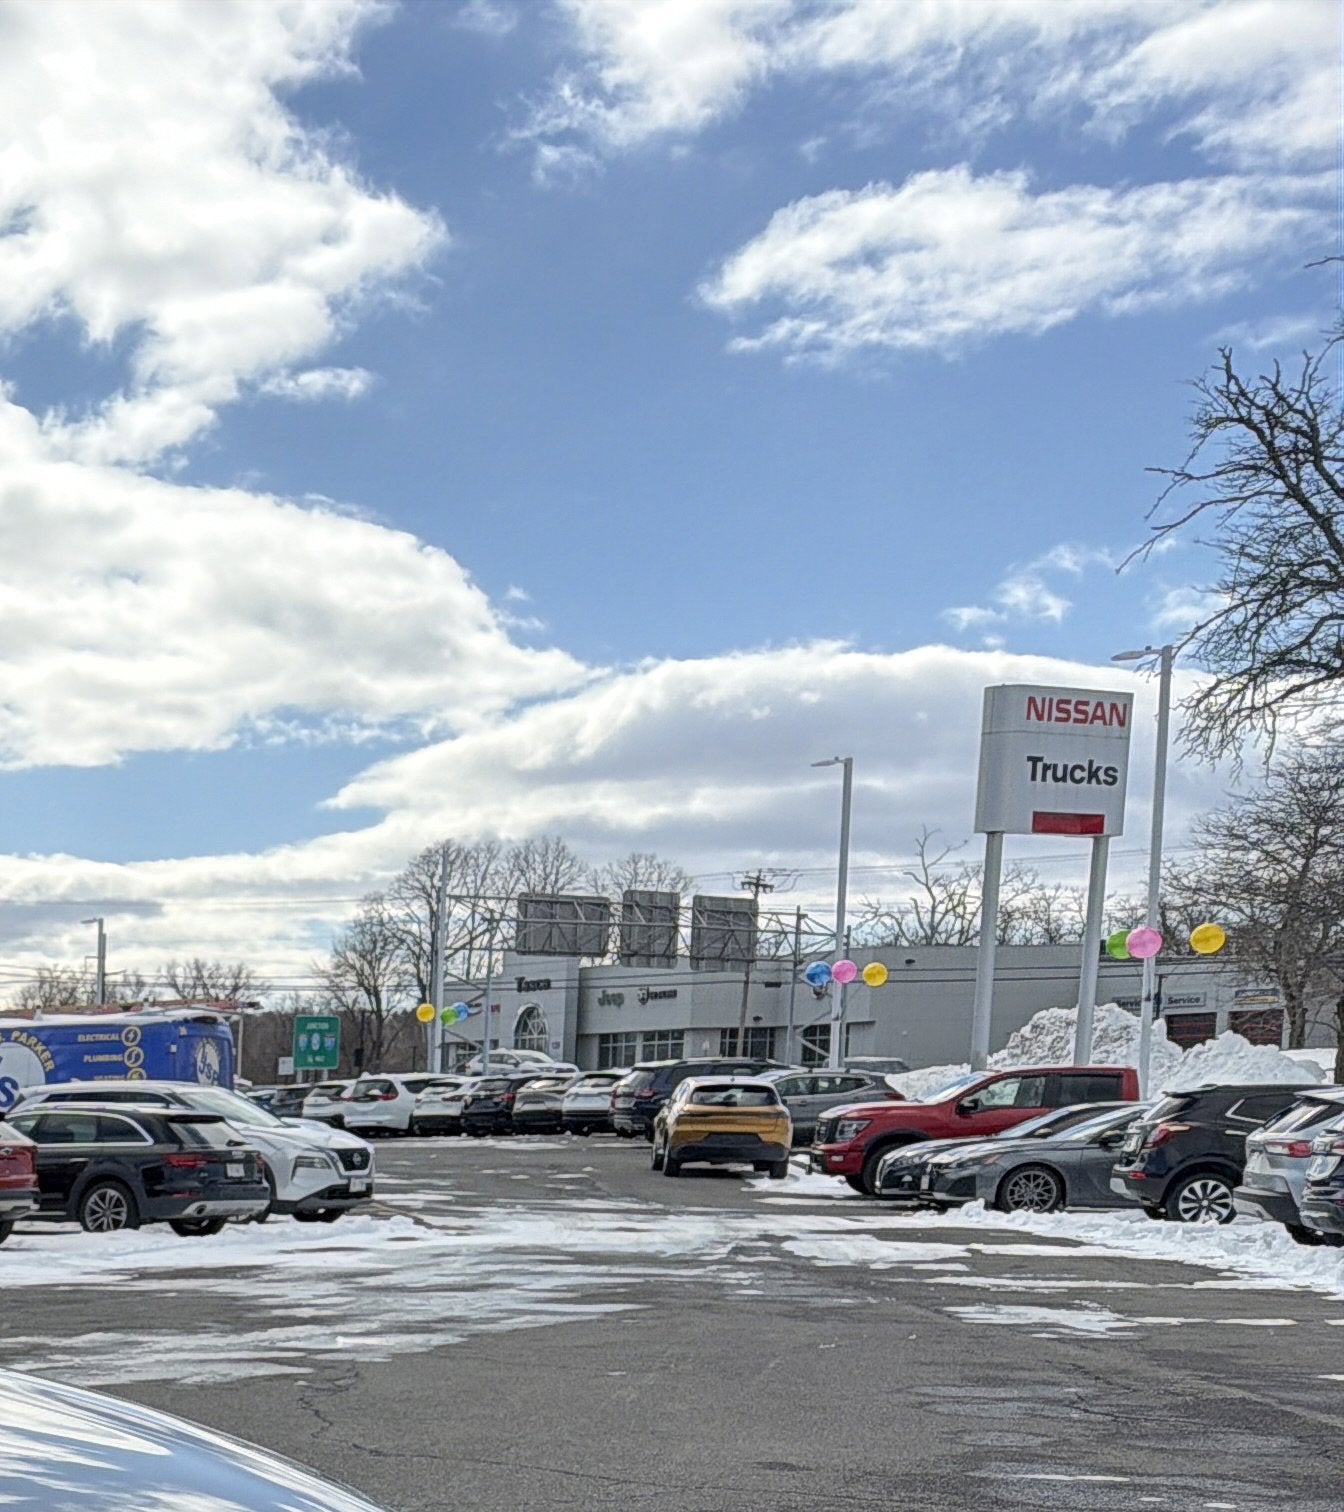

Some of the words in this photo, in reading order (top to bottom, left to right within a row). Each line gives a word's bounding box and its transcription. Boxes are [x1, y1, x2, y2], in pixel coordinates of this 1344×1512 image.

[1026, 696, 1128, 728] NISSAN
[1026, 755, 1119, 787] Trucks
[10, 1030, 56, 1073] PARKER
[77, 1033, 120, 1043] ELECTRICAL
